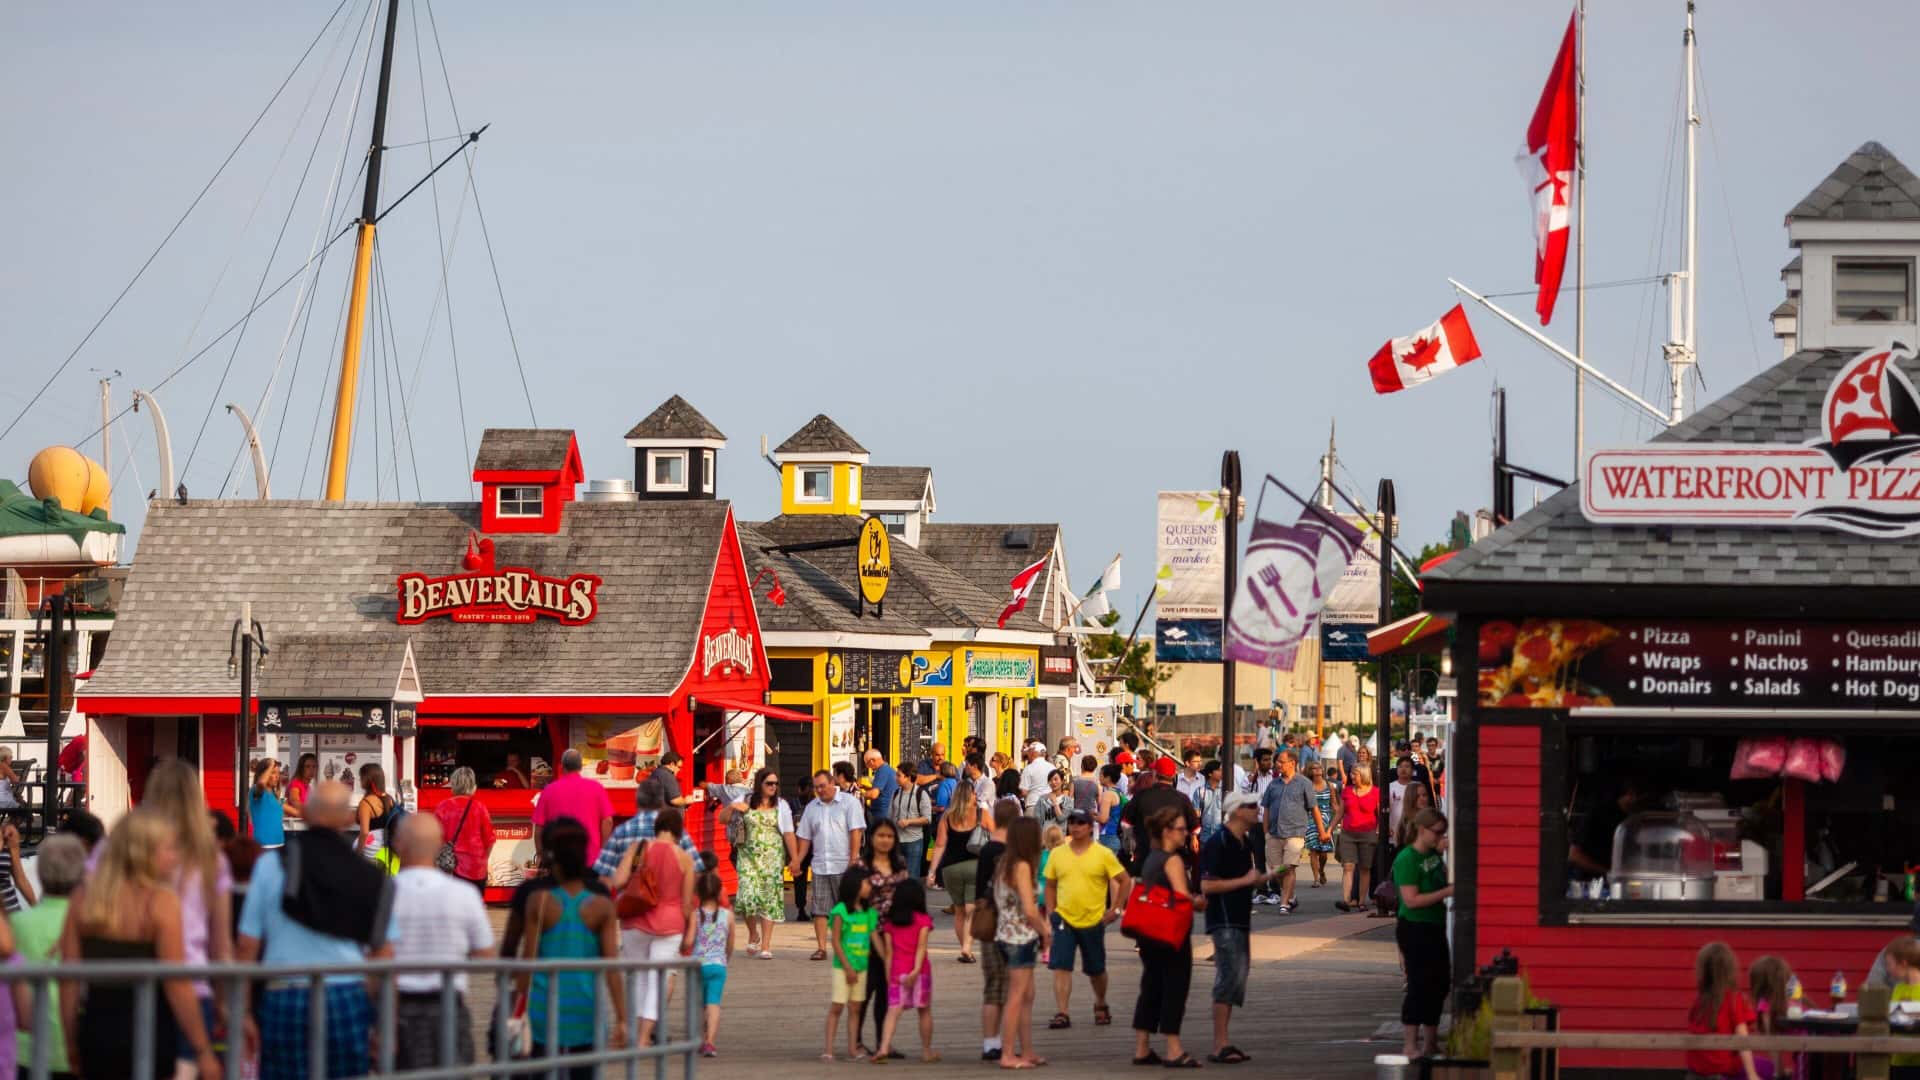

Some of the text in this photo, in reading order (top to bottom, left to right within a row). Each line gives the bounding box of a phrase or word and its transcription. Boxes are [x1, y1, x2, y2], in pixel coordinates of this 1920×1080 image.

[1601, 465, 1834, 500] WATERFRONT
[1165, 524, 1218, 536] QUEEN'S
[1165, 536, 1218, 545] LANDING
[1172, 552, 1211, 564] market
[1343, 566, 1369, 577] arket
[1643, 627, 1691, 644] Pizza
[1744, 628, 1801, 646] Panini
[1643, 652, 1702, 675] Wraps
[1744, 653, 1809, 671] Nachos
[1845, 654, 1920, 678] Hambur
[1642, 676, 1712, 694] Donairs
[1743, 677, 1801, 695] Salads
[1845, 679, 1920, 702] Hot Dog
